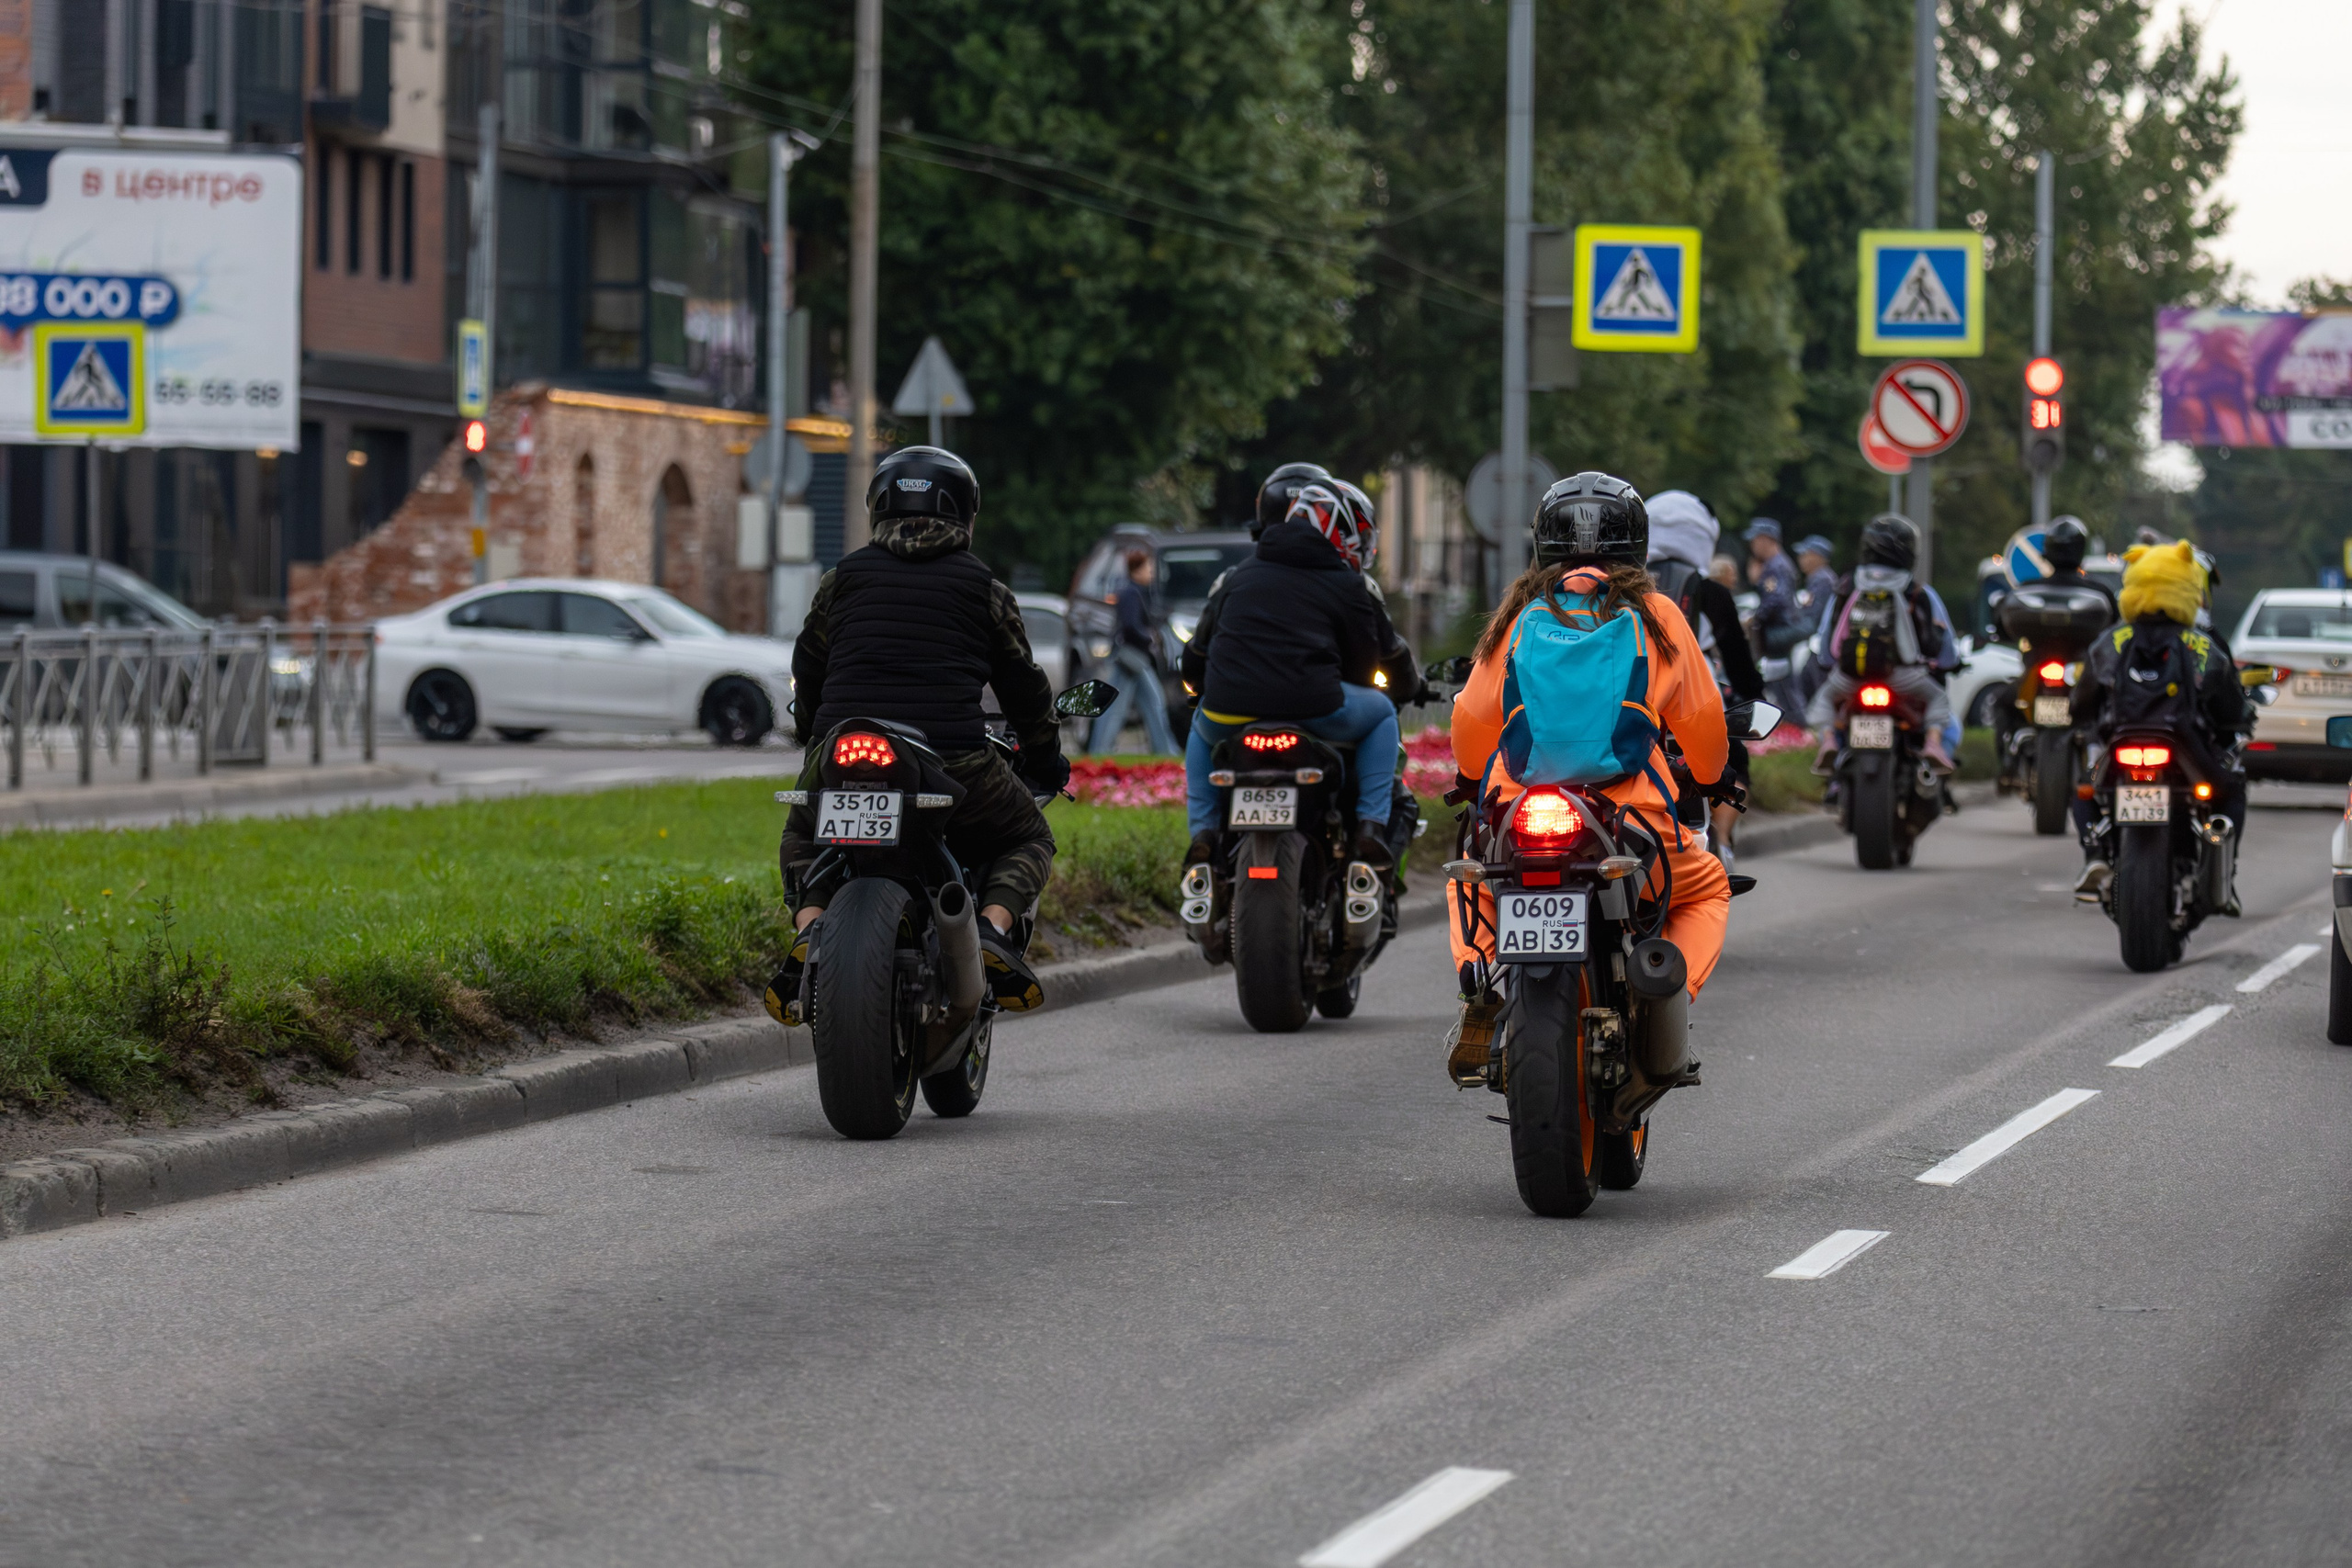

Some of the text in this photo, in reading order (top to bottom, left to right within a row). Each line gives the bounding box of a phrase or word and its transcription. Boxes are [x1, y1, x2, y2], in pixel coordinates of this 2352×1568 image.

[115, 169, 263, 209] центре
[45, 277, 131, 318] 000
[832, 794, 888, 811] 3510
[1242, 790, 1288, 802] 8659
[2124, 790, 2163, 801] 3441
[1268, 810, 1290, 822] 39
[2147, 808, 2165, 819] 39
[865, 820, 892, 837] 39
[1512, 897, 1574, 918] 0609
[1549, 930, 1579, 950] 39
